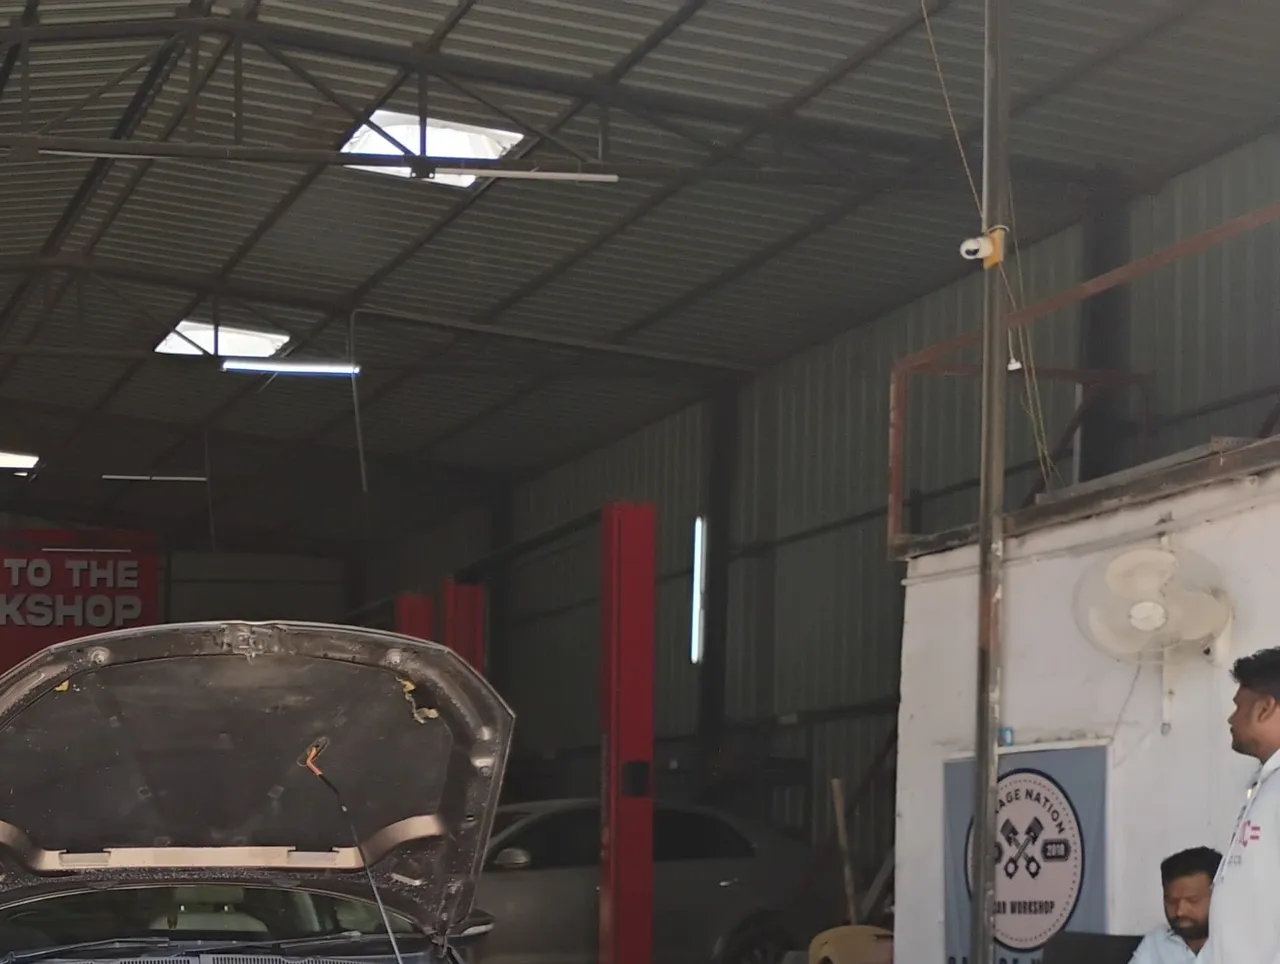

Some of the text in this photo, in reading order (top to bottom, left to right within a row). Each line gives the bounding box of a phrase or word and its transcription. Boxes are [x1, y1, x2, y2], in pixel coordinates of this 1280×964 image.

[3, 558, 51, 588] TO
[65, 559, 139, 589] THE
[1025, 788, 1066, 835] NATION
[1009, 899, 1056, 915] WORKSHOP
